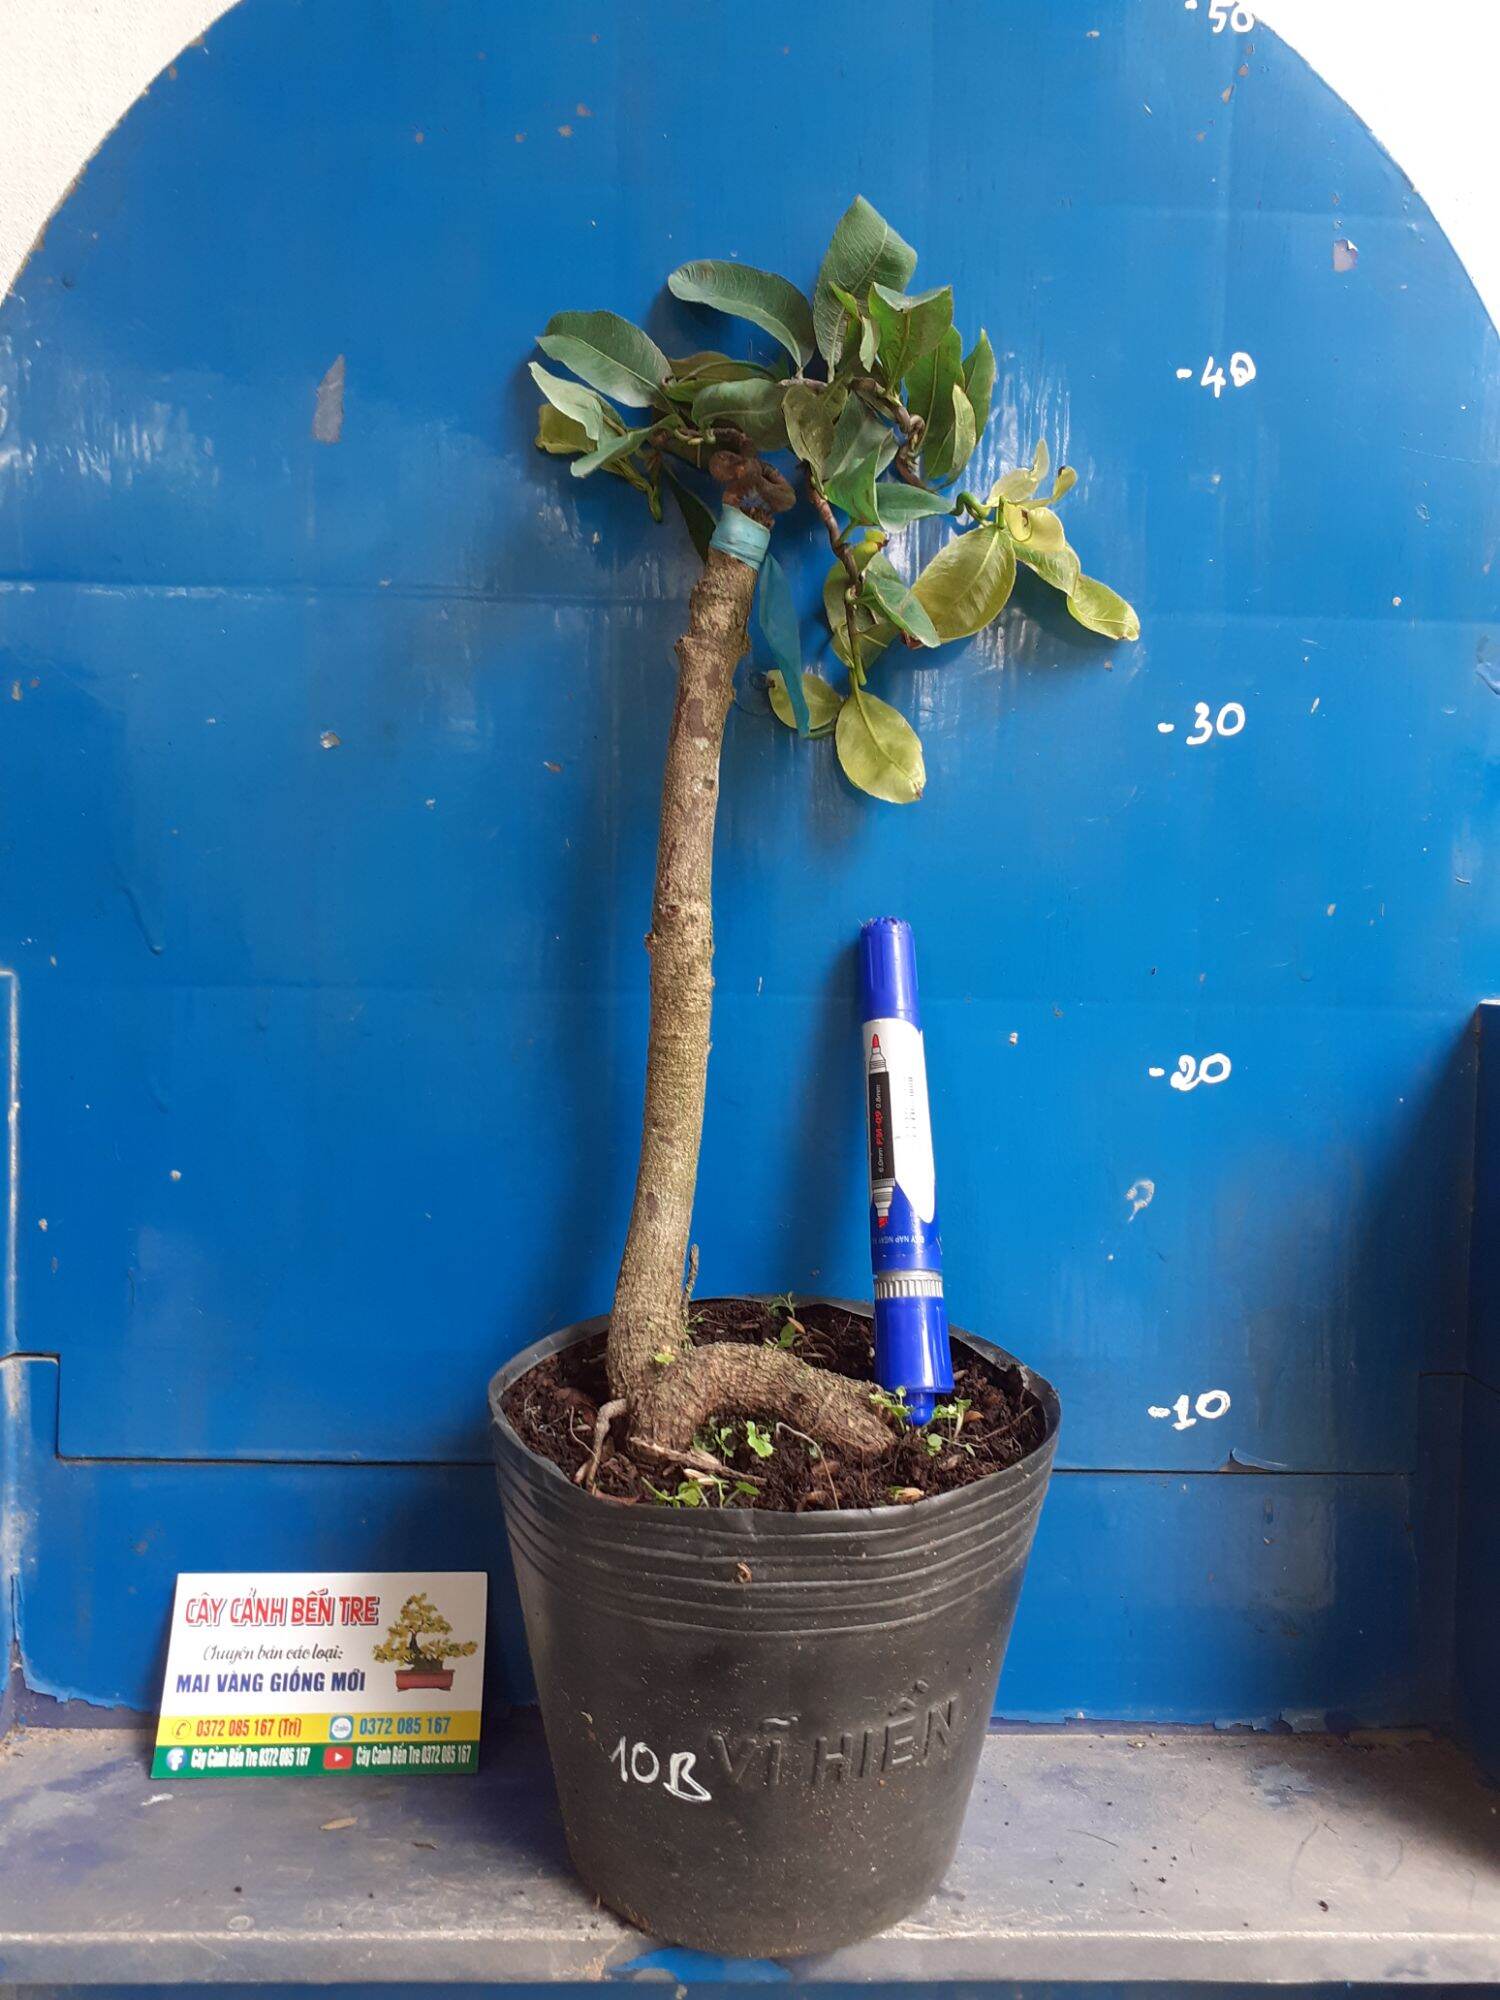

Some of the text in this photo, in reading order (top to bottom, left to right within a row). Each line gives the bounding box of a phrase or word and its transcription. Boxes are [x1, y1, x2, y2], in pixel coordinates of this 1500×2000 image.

[339, 1595, 380, 1626] TRE
[176, 1673, 211, 1693] MAI
[196, 1719, 226, 1737] 0372
[228, 1718, 250, 1737] 085
[253, 1718, 275, 1736] 167
[359, 1716, 452, 1736] 0372 085 167
[421, 1744, 441, 1764] 0372
[457, 1744, 472, 1764] 167
